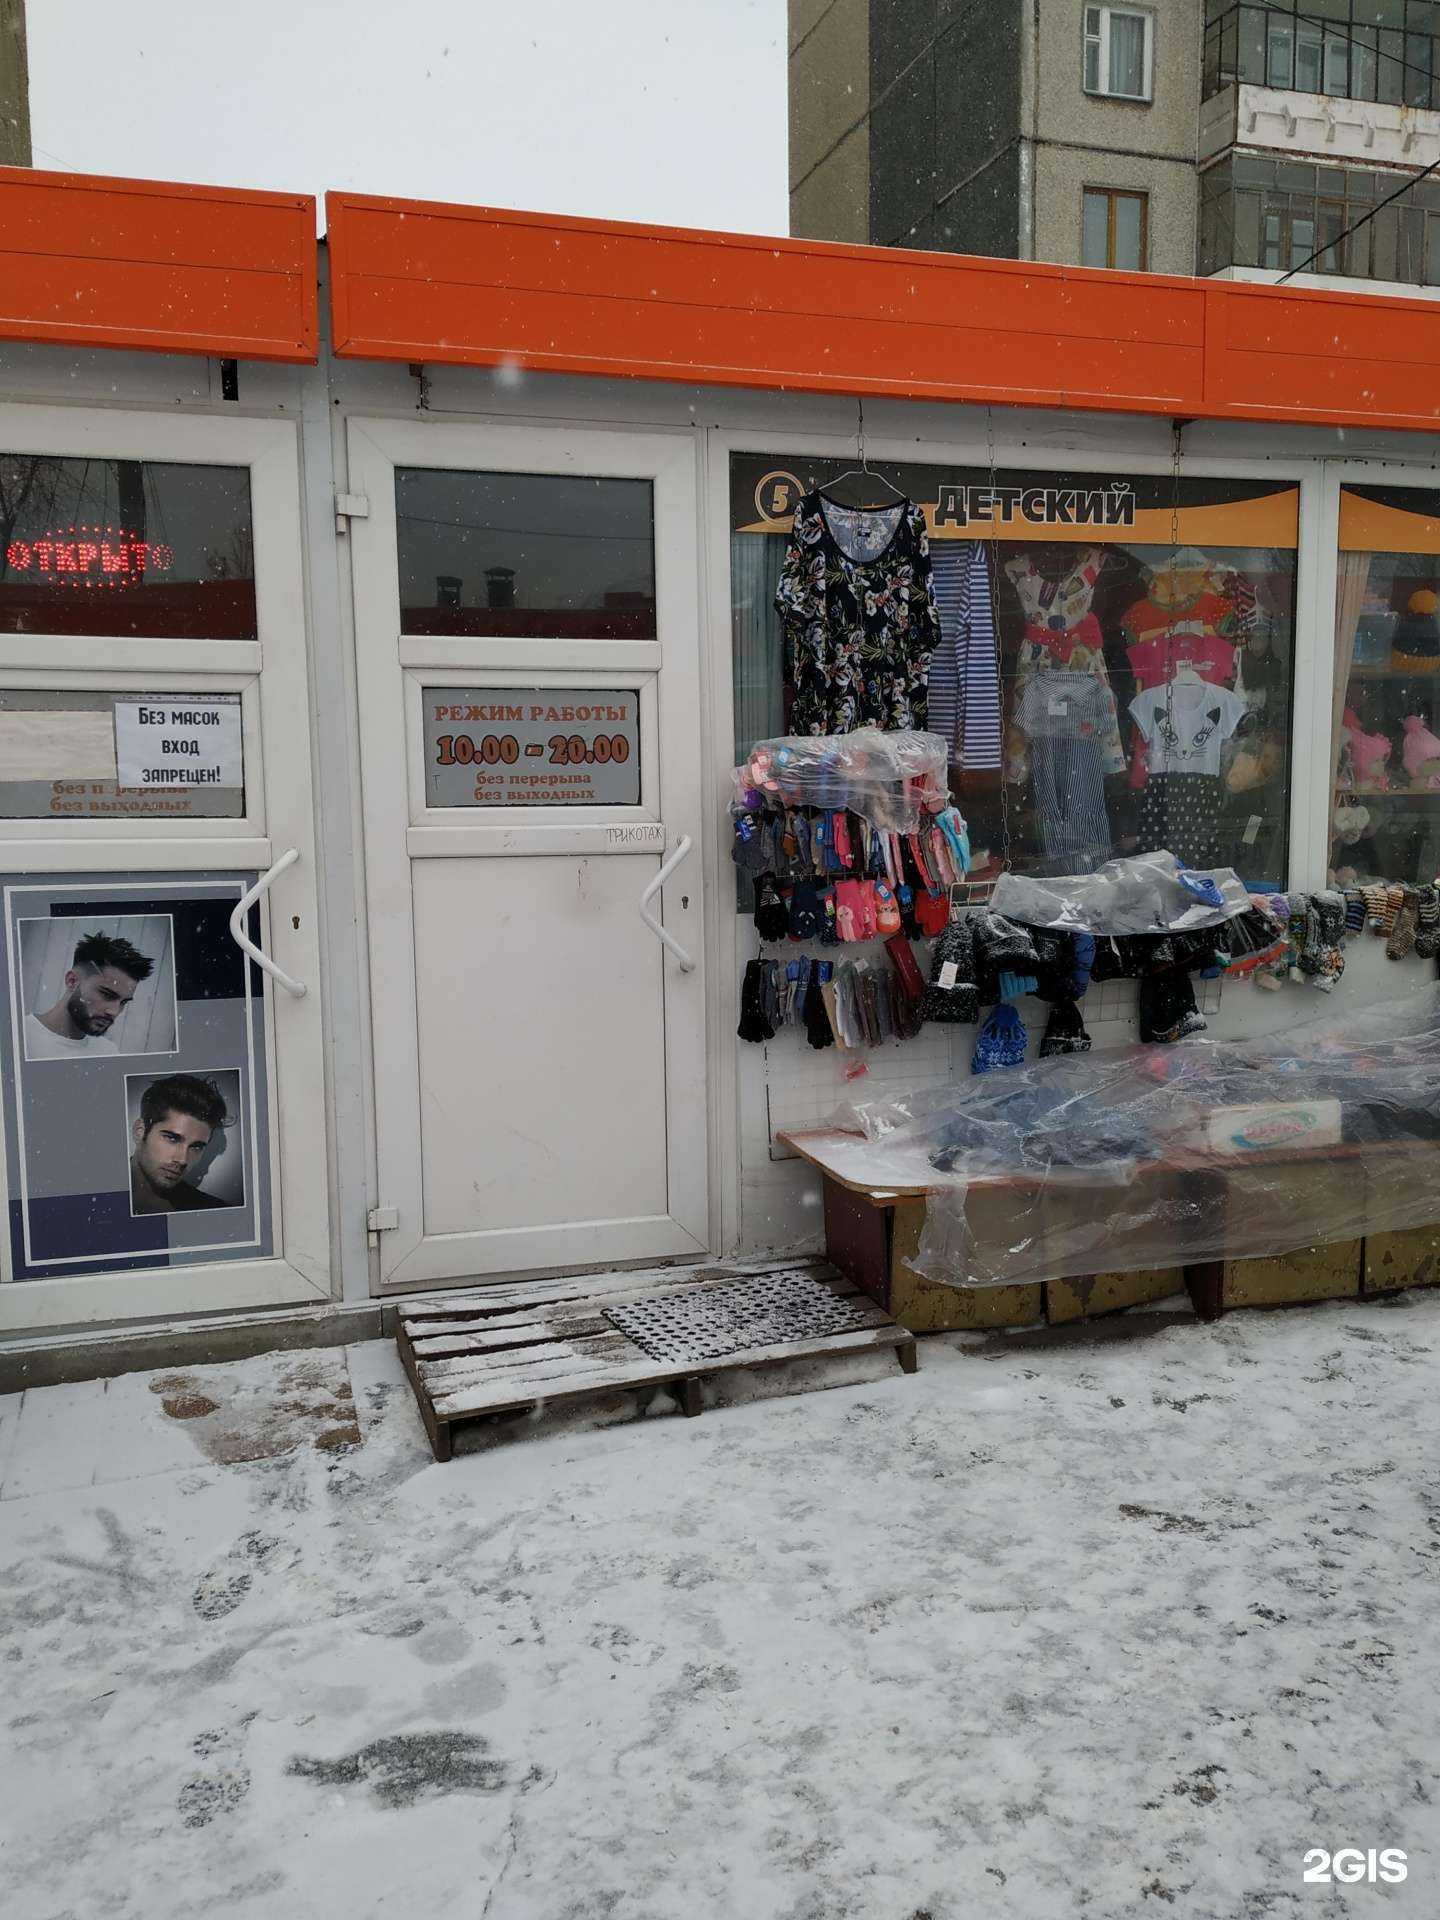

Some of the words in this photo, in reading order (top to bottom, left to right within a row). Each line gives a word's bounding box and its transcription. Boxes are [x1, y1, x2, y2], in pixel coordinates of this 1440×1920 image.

[772, 485, 789, 512] 5
[933, 482, 1137, 528] ДЕТСКИЙ
[7, 541, 174, 573] ОТКРЫТО
[434, 706, 523, 721] РЕЖИМ
[529, 705, 628, 721] РАБОТЫ
[436, 735, 519, 765] 10.00
[548, 734, 630, 765] 20.00
[476, 771, 504, 785] без
[509, 773, 592, 787] перерыва
[52, 781, 85, 795] без
[474, 787, 502, 801] без
[507, 789, 595, 801] выходных
[50, 797, 83, 812] без
[89, 800, 192, 813] выходных
[606, 826, 663, 844] ТРИКОТАЖ
